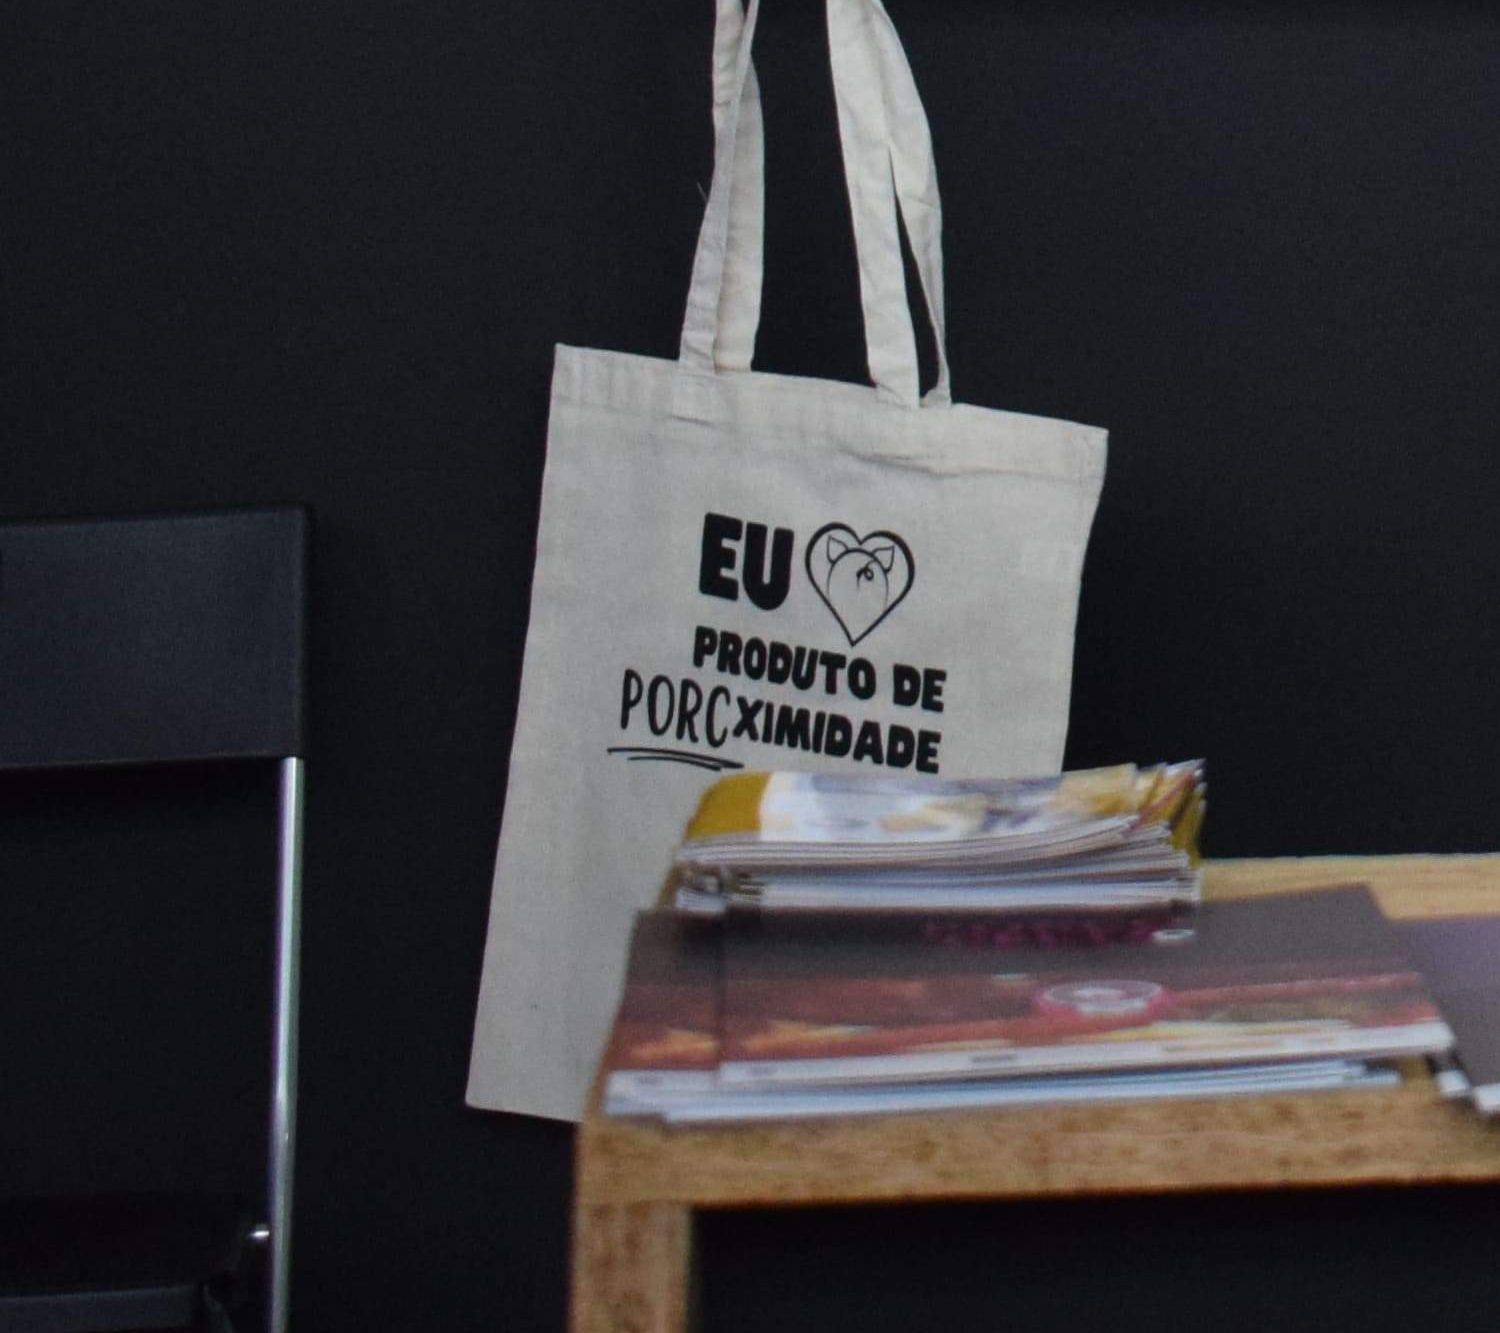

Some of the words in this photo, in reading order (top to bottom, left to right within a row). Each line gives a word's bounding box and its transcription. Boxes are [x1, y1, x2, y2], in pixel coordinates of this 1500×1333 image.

[699, 512, 795, 611] EU
[692, 624, 877, 701] PRODUTO
[892, 662, 948, 713] DE
